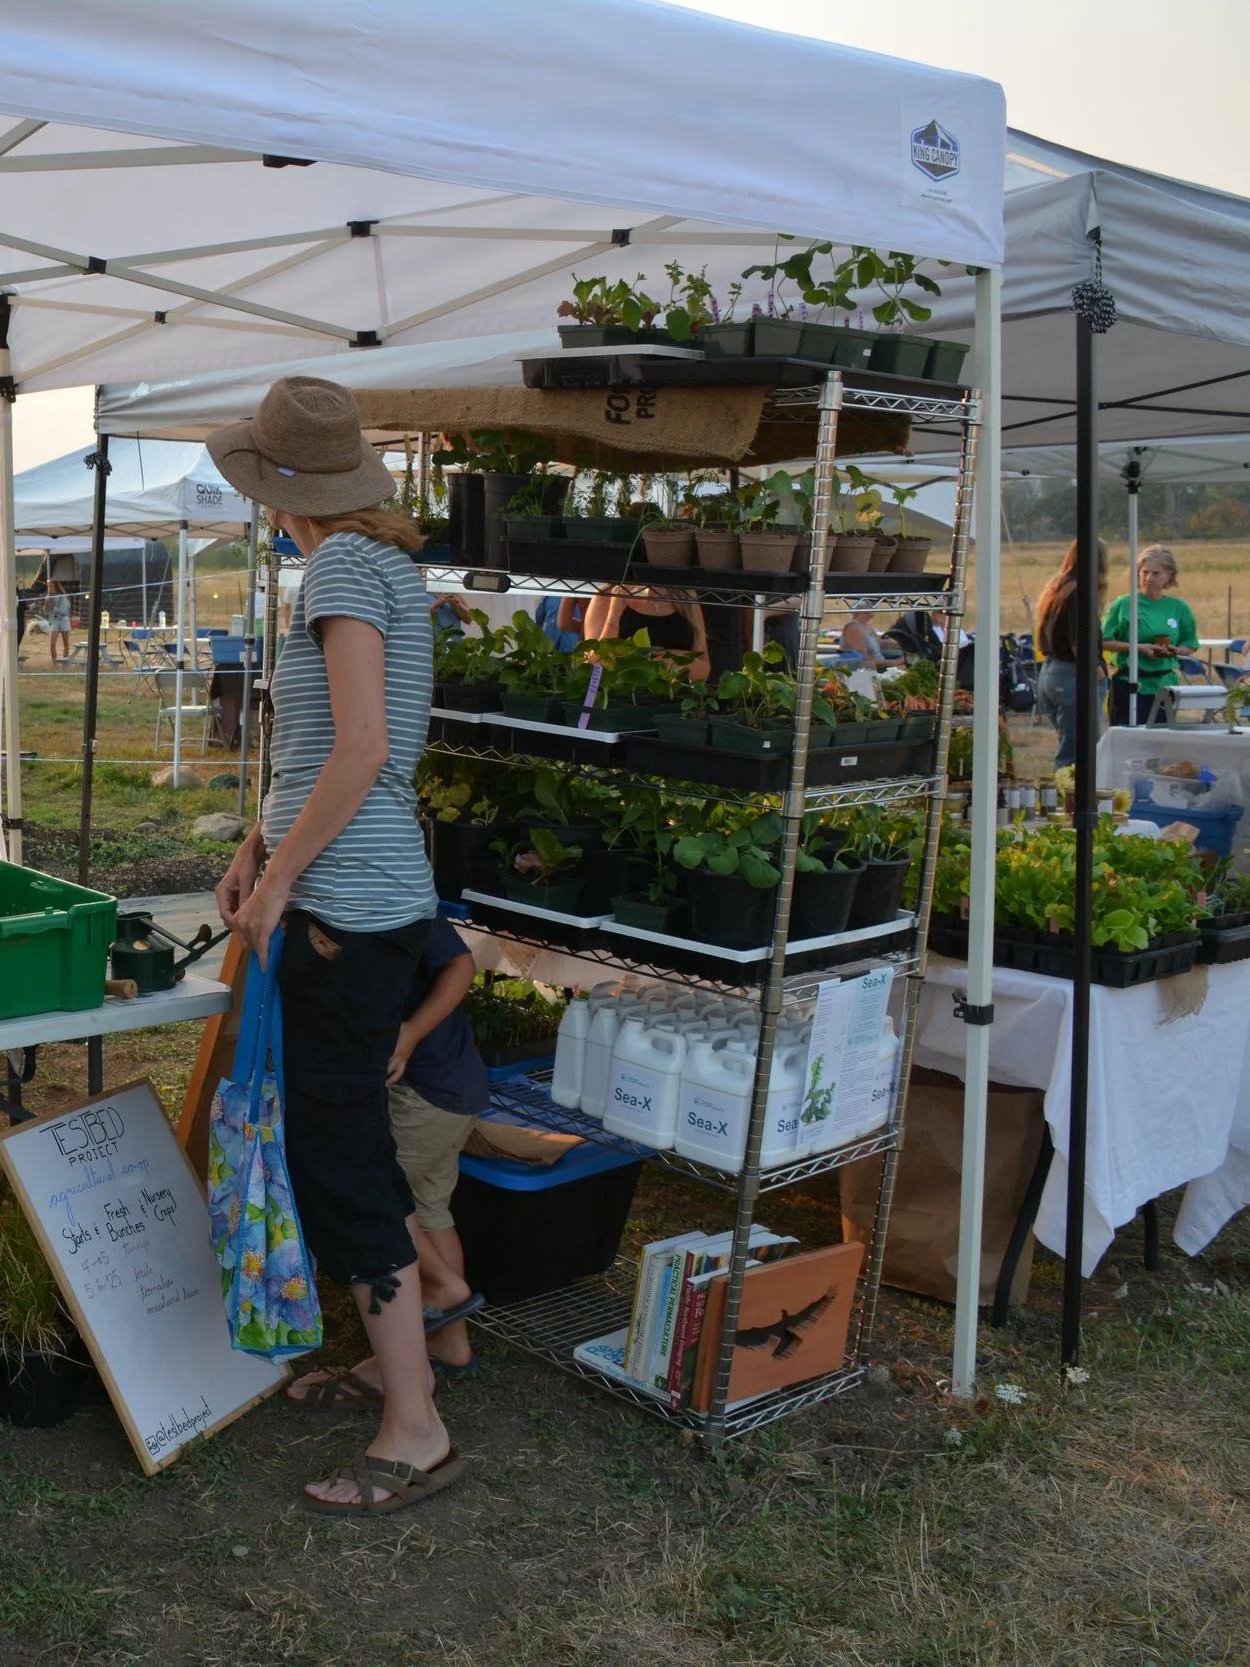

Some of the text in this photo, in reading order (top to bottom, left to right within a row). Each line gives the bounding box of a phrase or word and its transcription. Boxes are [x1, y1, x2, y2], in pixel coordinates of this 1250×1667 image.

[913, 143, 959, 167] KING CANOPY
[196, 495, 222, 504] SHADE
[862, 973, 887, 989] Sea-X
[614, 1087, 652, 1111] Sea-X
[39, 1106, 125, 1157] TESTBED
[687, 1111, 728, 1136] Sea-X
[68, 1141, 119, 1167] PROJECT
[48, 1158, 152, 1227] agricultural co-op
[103, 1198, 131, 1221] Fresh
[140, 1188, 177, 1210] Nursery
[62, 1222, 92, 1255] Starts
[105, 1217, 146, 1242] Bunches
[153, 1204, 176, 1226] Crops
[669, 1254, 681, 1296] PRACTICAL
[659, 1297, 676, 1357] PERMACULTURE
[156, 1394, 213, 1447] @testbedproject
